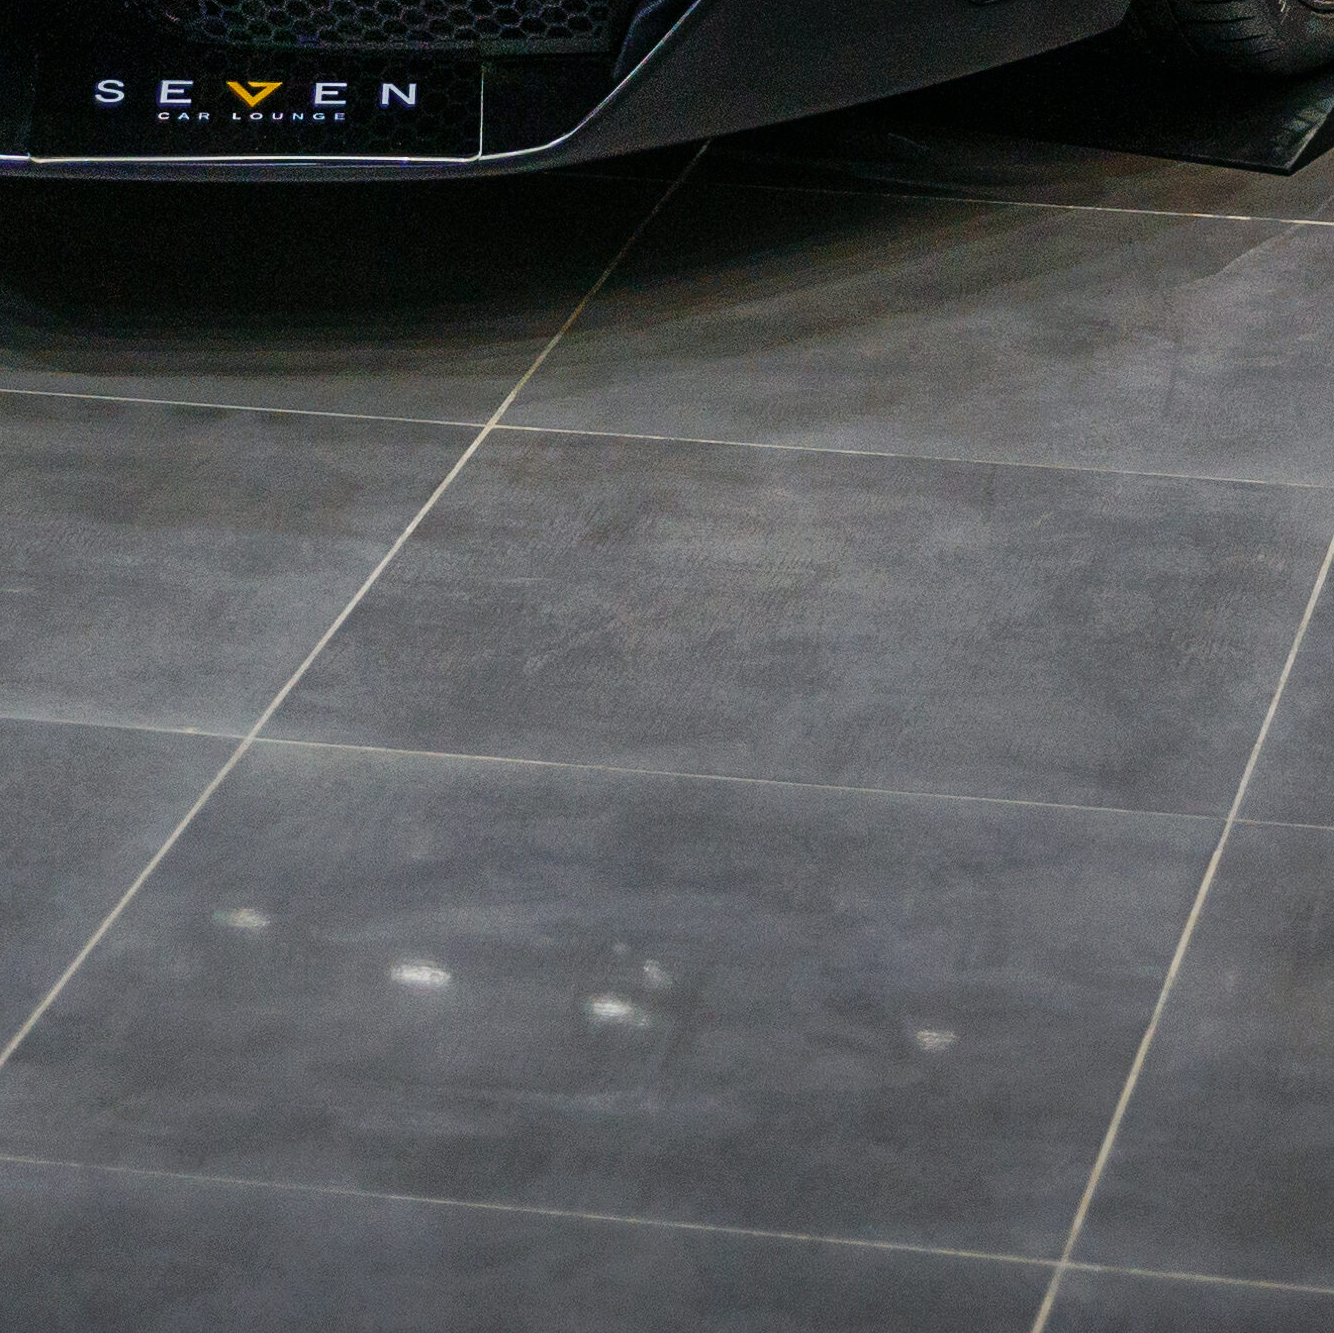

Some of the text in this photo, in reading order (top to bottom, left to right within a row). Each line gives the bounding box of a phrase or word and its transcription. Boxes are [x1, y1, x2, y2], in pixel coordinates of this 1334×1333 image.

[94, 79, 417, 107] SEVEN
[157, 111, 346, 121] CAR LOUNGE
